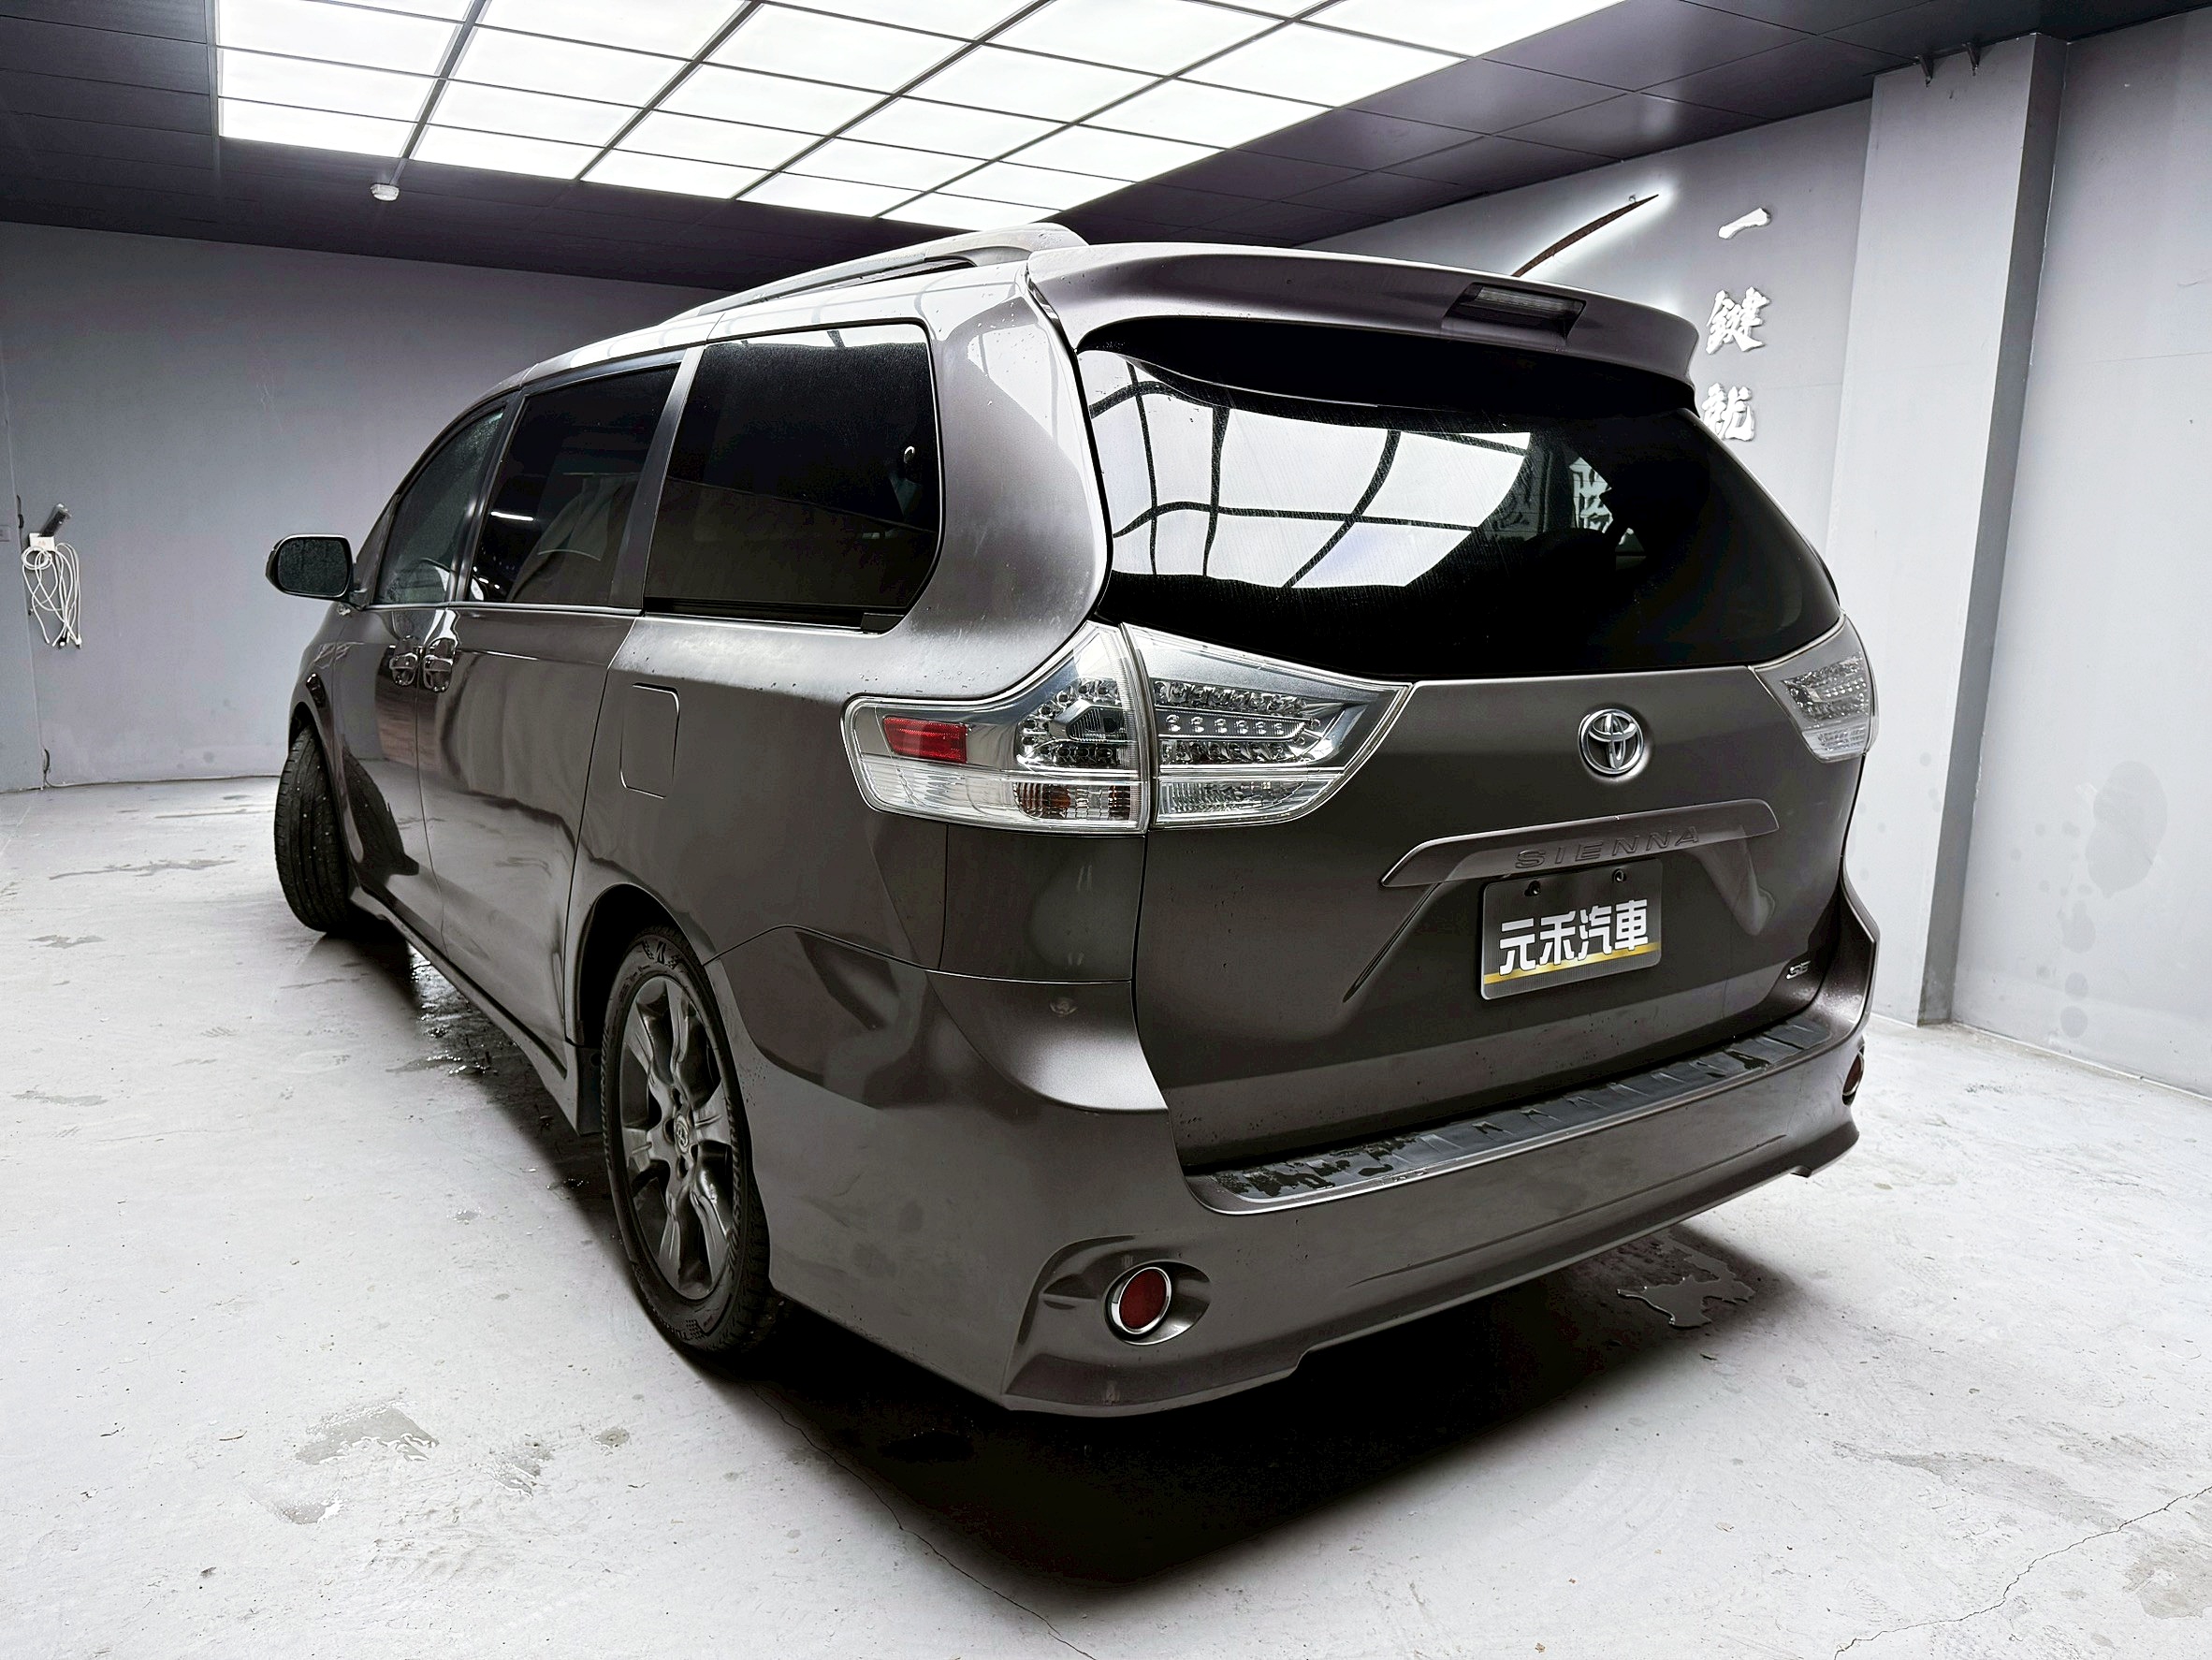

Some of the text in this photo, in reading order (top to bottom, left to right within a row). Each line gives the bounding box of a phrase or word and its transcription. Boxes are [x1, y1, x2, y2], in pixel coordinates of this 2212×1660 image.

[1515, 825, 1700, 869] SIENNA
[1499, 898, 1650, 976] 元禾汽車
[1786, 960, 1812, 980] SE
